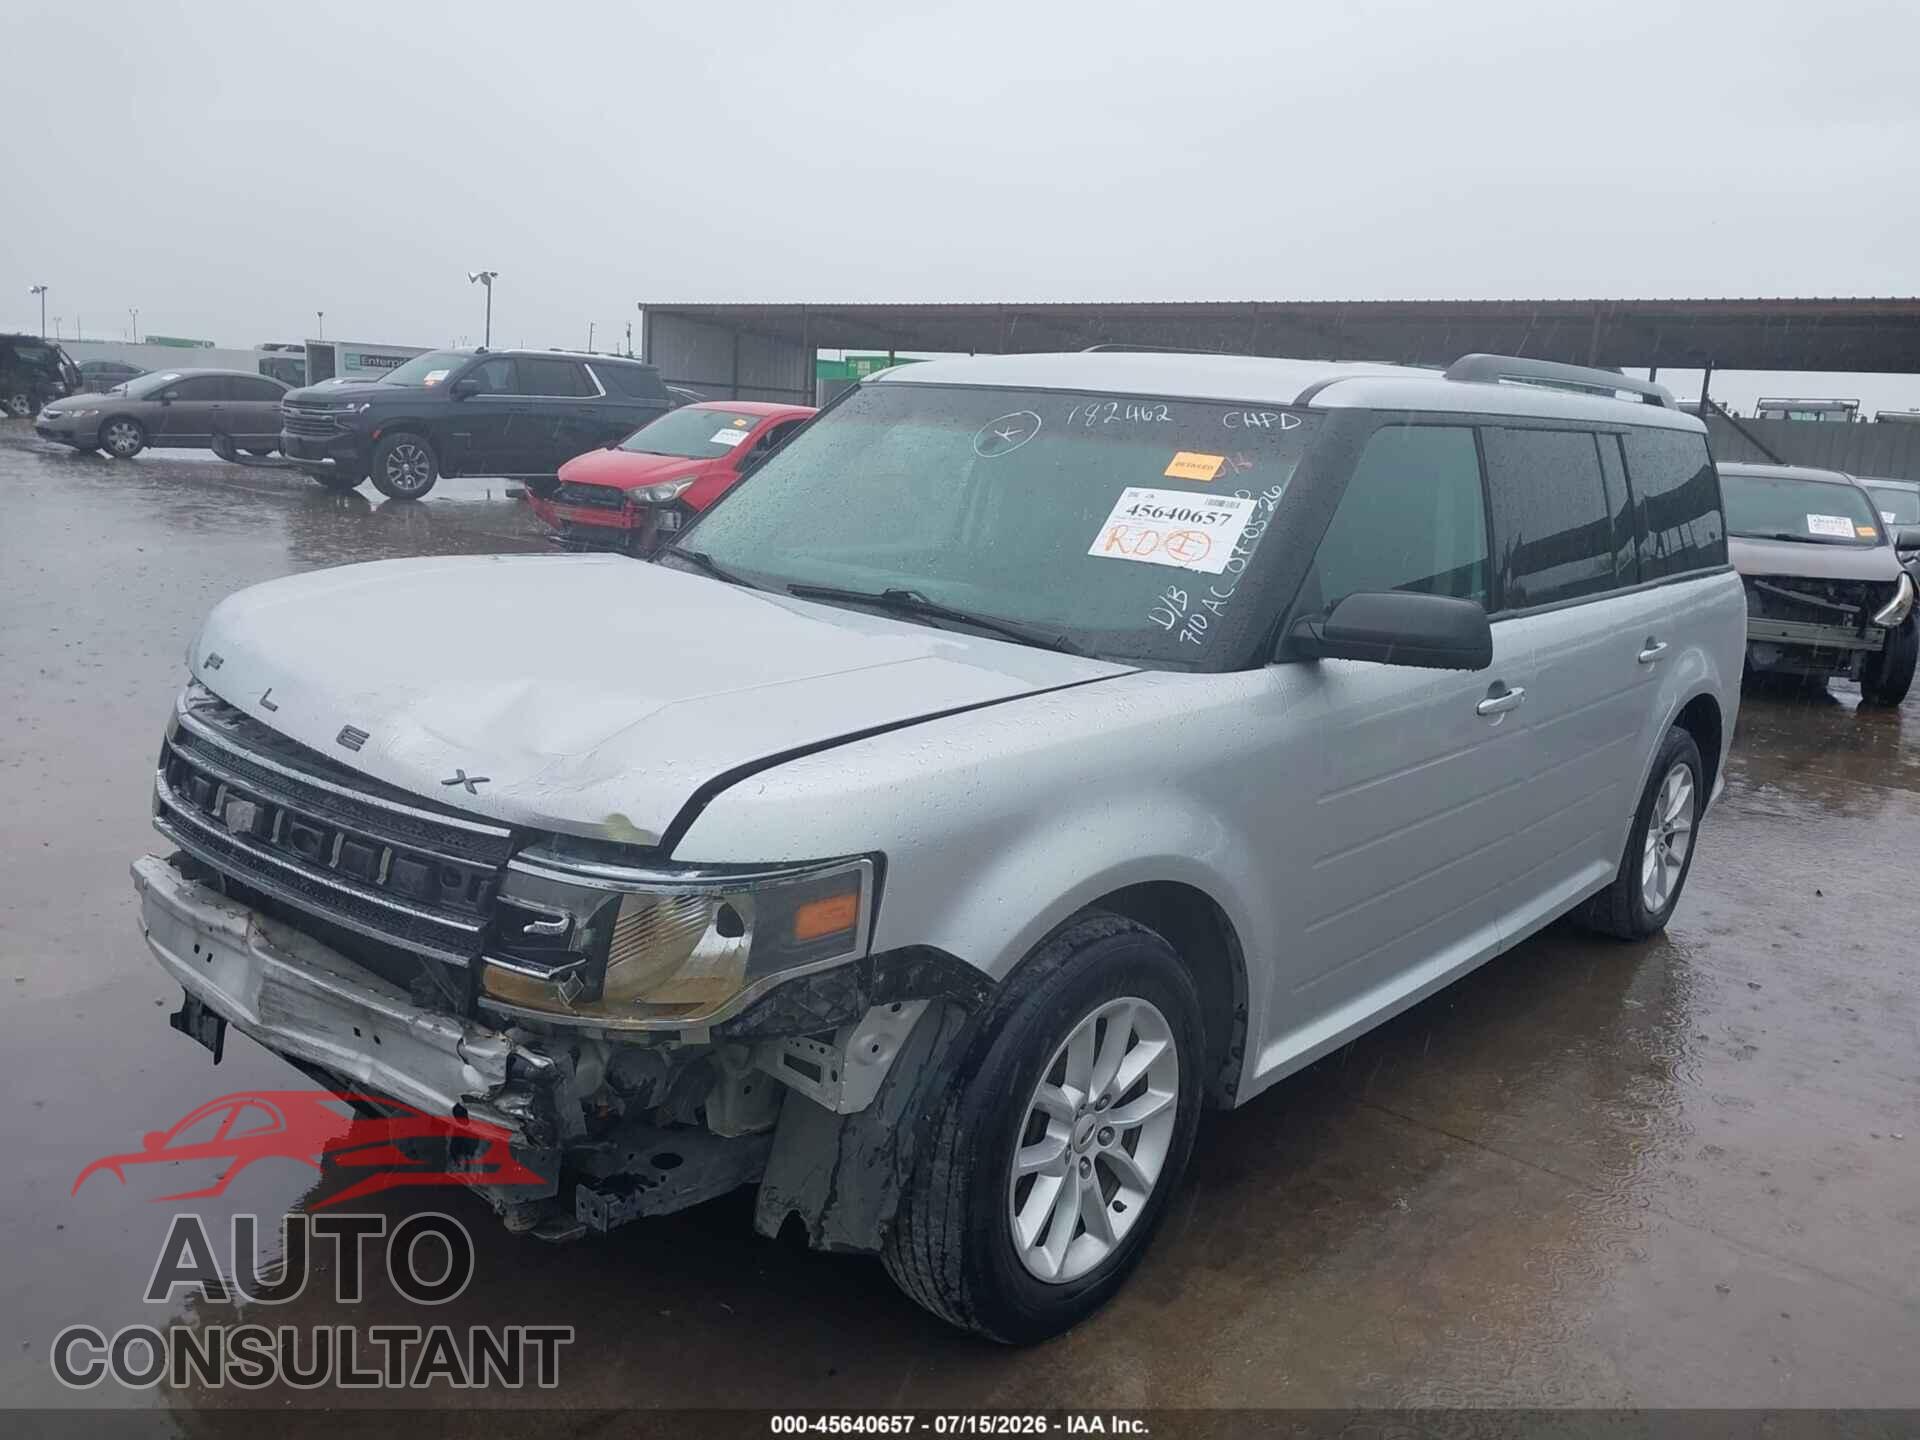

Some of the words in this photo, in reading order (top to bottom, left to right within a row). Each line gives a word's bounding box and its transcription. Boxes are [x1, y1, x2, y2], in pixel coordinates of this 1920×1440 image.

[1066, 401, 1173, 427] 182462
[1126, 503, 1233, 527] 45640657
[1201, 585, 1235, 617] AC
[203, 651, 491, 794] FLEX
